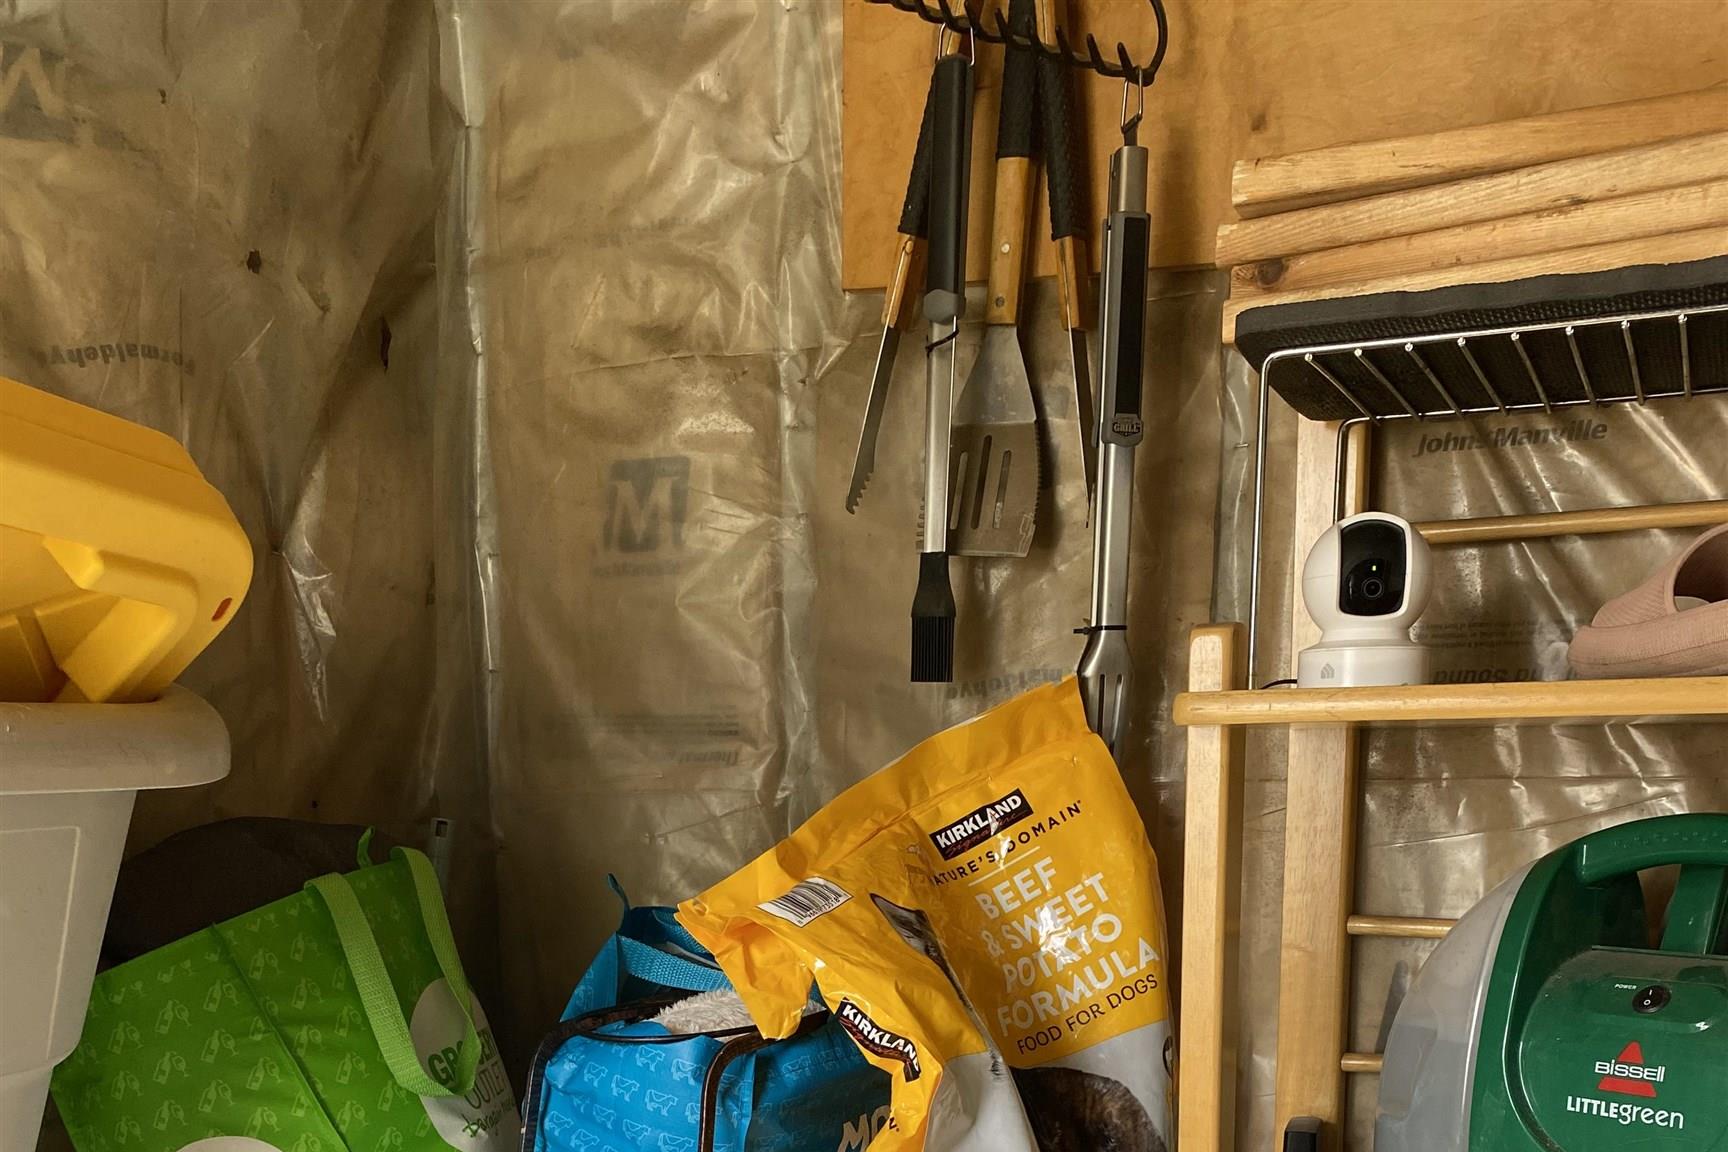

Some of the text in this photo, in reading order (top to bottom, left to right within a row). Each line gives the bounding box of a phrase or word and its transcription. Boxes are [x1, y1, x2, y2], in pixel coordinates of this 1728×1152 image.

[936, 795, 1022, 849] KIRKLAND
[975, 856, 1057, 920] BEEF
[980, 872, 1110, 957] & SWEET
[996, 937, 1160, 1037] FORMULA
[1002, 913, 1123, 994] POTATO
[1016, 973, 1159, 1055] FOOD FOR DOGS
